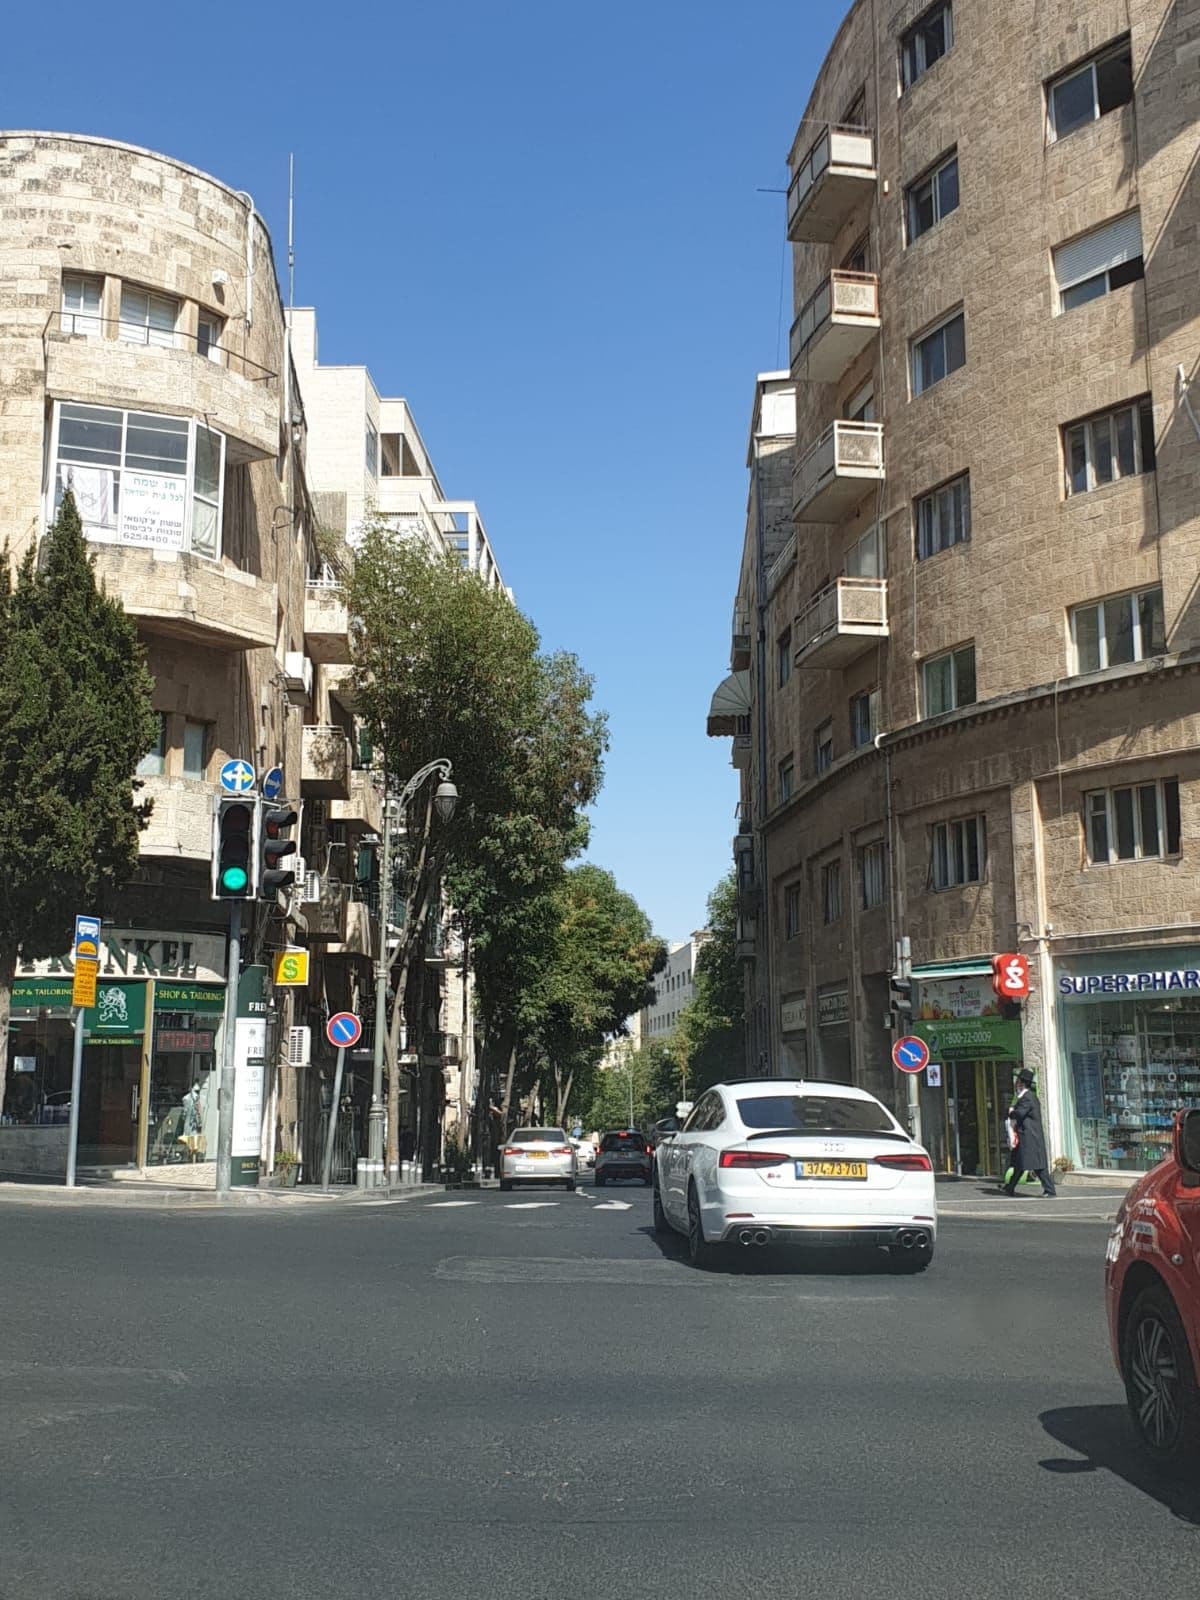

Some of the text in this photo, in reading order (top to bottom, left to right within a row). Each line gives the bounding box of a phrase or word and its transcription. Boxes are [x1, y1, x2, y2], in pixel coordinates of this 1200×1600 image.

[133, 477, 159, 488] שמח
[1059, 970, 1200, 995] SUPER-PHAR
[158, 990, 180, 1000] SHOP
